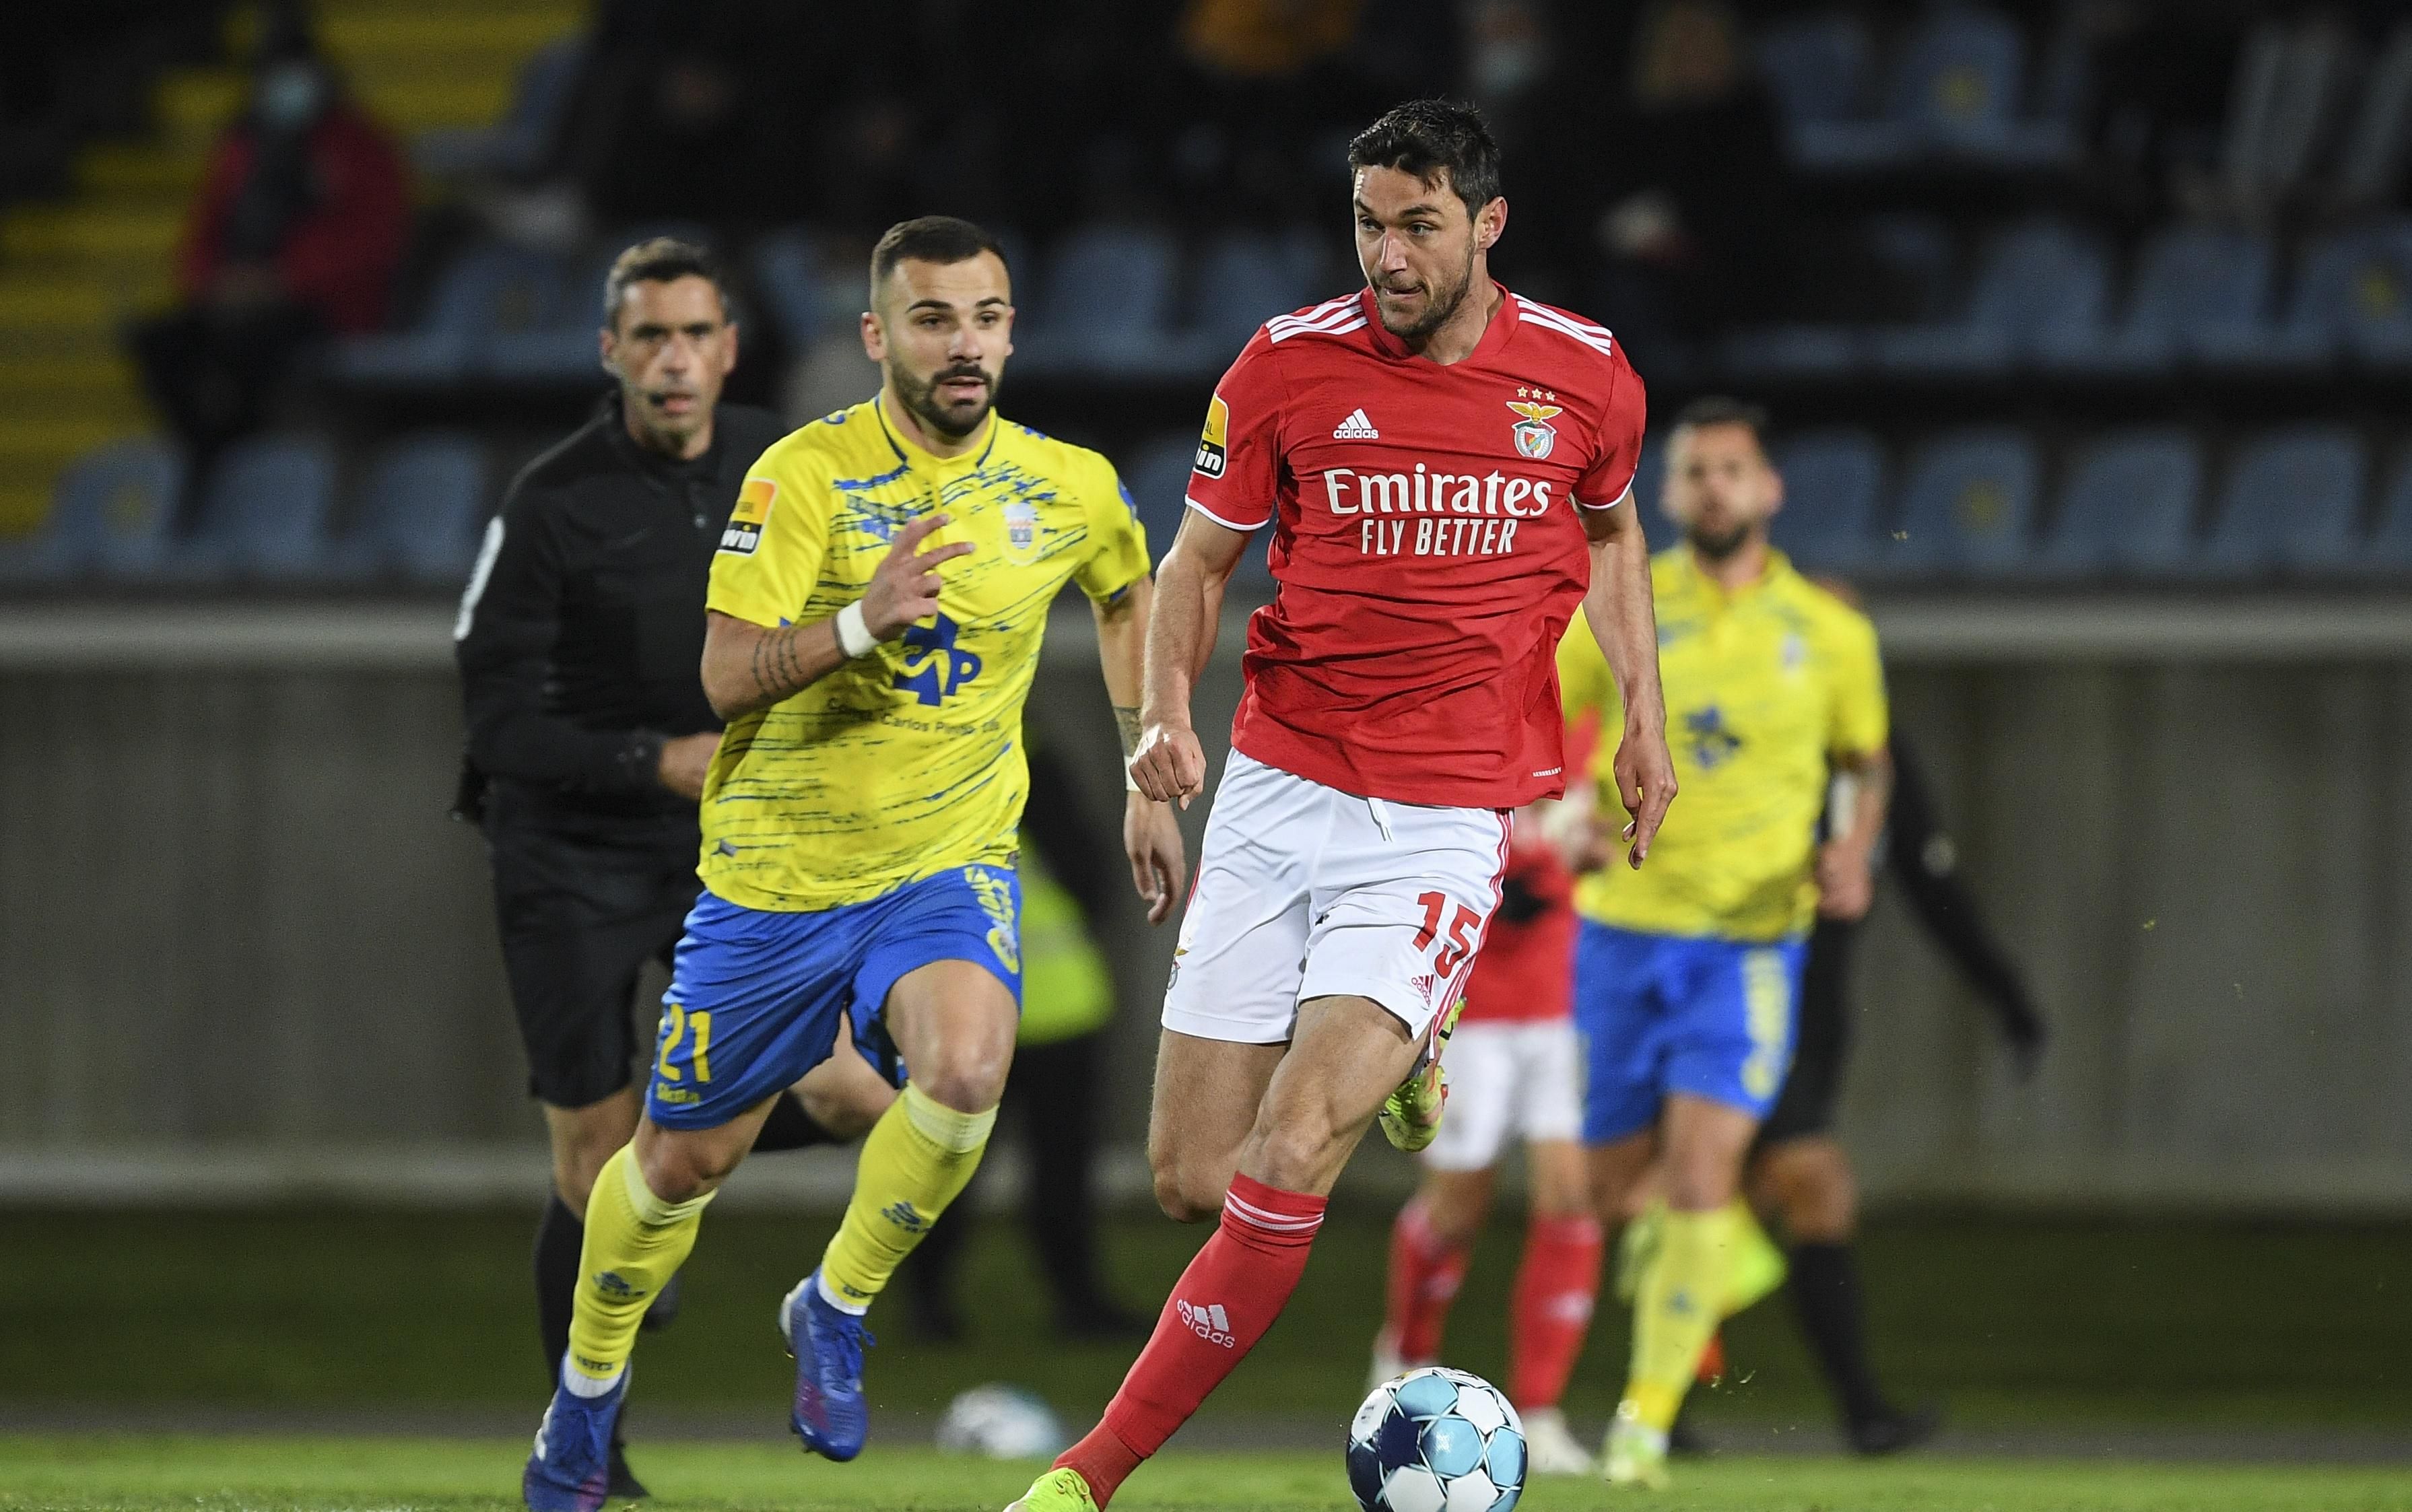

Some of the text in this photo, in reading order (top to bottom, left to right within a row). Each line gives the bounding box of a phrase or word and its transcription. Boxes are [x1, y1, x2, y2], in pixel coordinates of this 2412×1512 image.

[1333, 426, 1379, 440] adidas
[1322, 462, 1551, 517] Emirates
[1362, 518, 1518, 556] FLY BETTER
[1412, 891, 1482, 980] 15
[658, 1002, 712, 1083] 21
[1176, 1298, 1236, 1348] adidas
